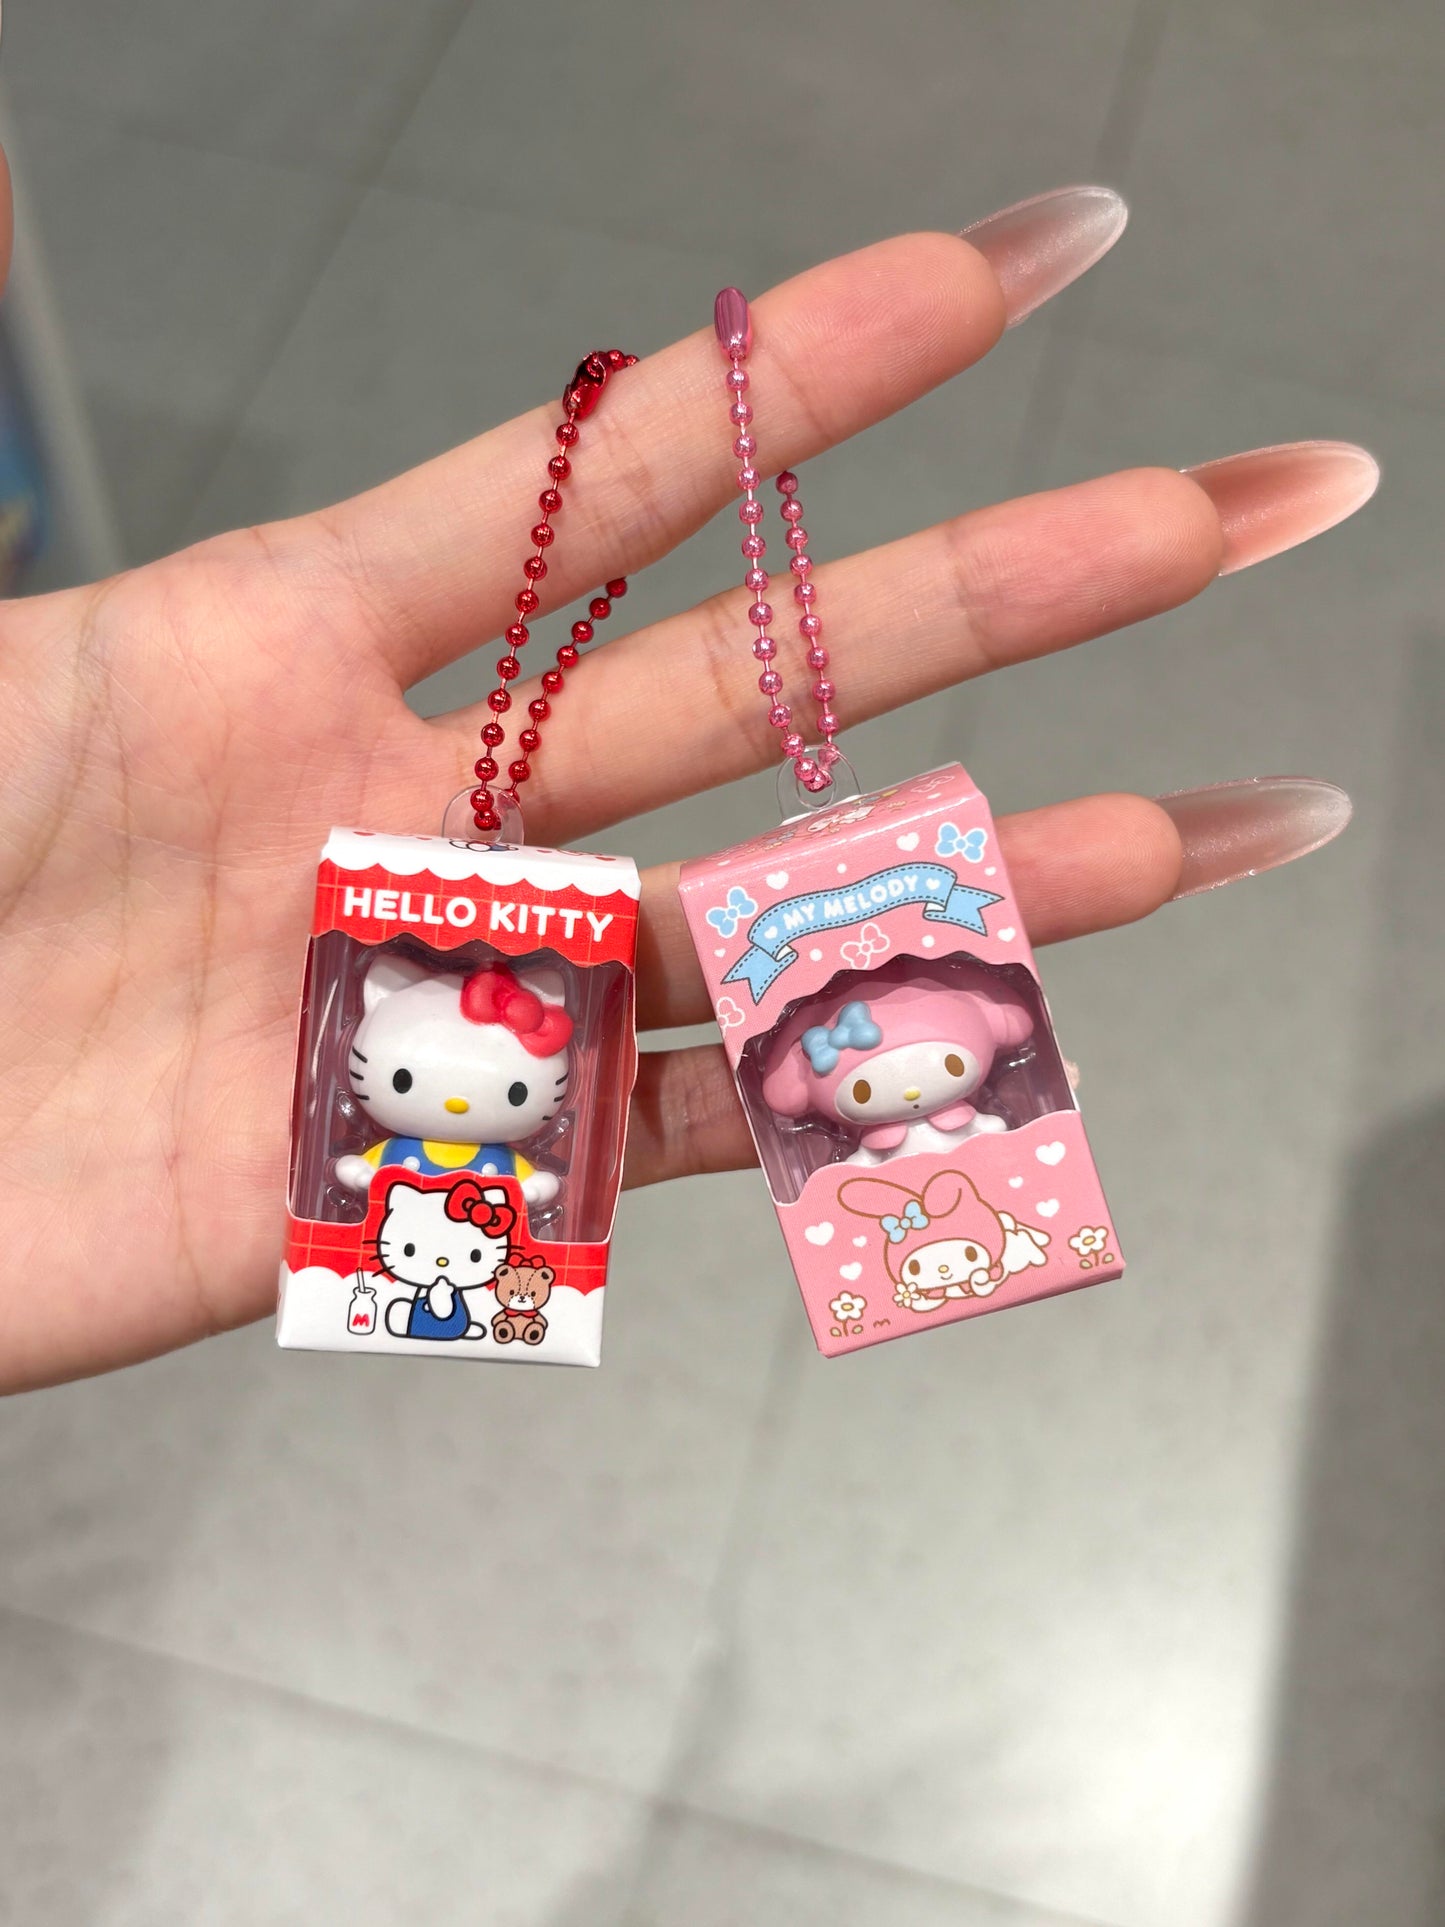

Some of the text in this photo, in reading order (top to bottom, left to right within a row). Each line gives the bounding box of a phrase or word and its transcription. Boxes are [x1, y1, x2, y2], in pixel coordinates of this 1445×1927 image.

[344, 886, 614, 943] HELLO KITTY
[782, 875, 919, 931] MY MELODY
[352, 1313, 370, 1327] M
